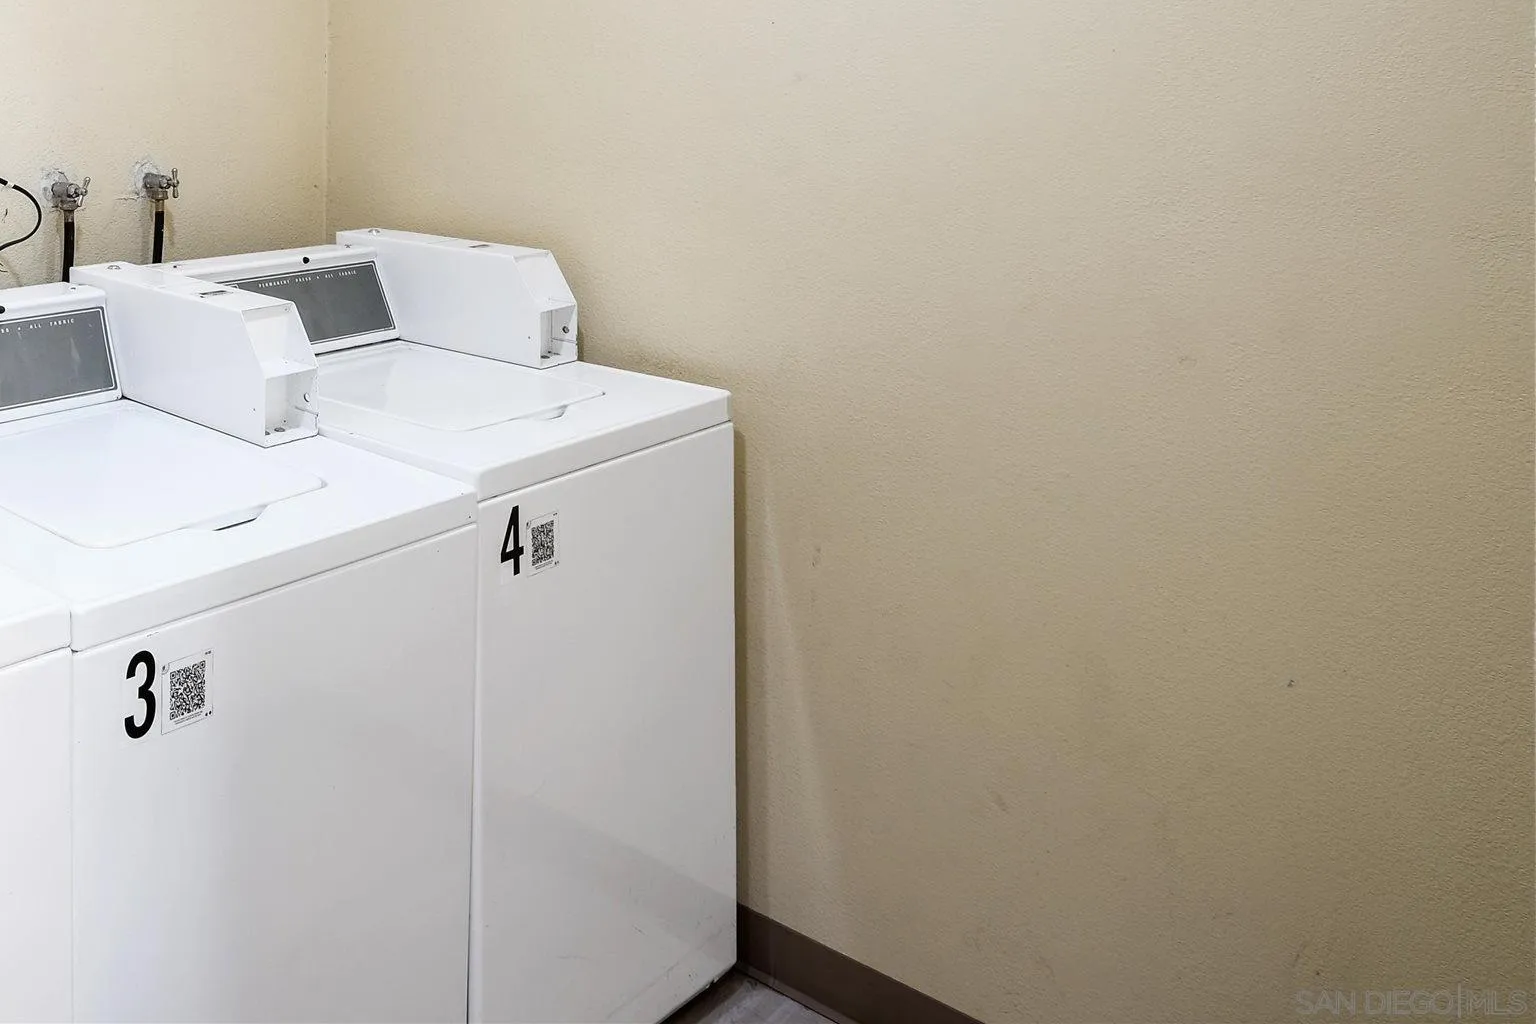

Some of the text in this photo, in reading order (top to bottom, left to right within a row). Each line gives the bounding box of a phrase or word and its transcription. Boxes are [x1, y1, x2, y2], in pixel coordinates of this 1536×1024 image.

[50, 318, 74, 326] FABRIC
[501, 505, 524, 576] 4
[125, 650, 156, 739] 3
